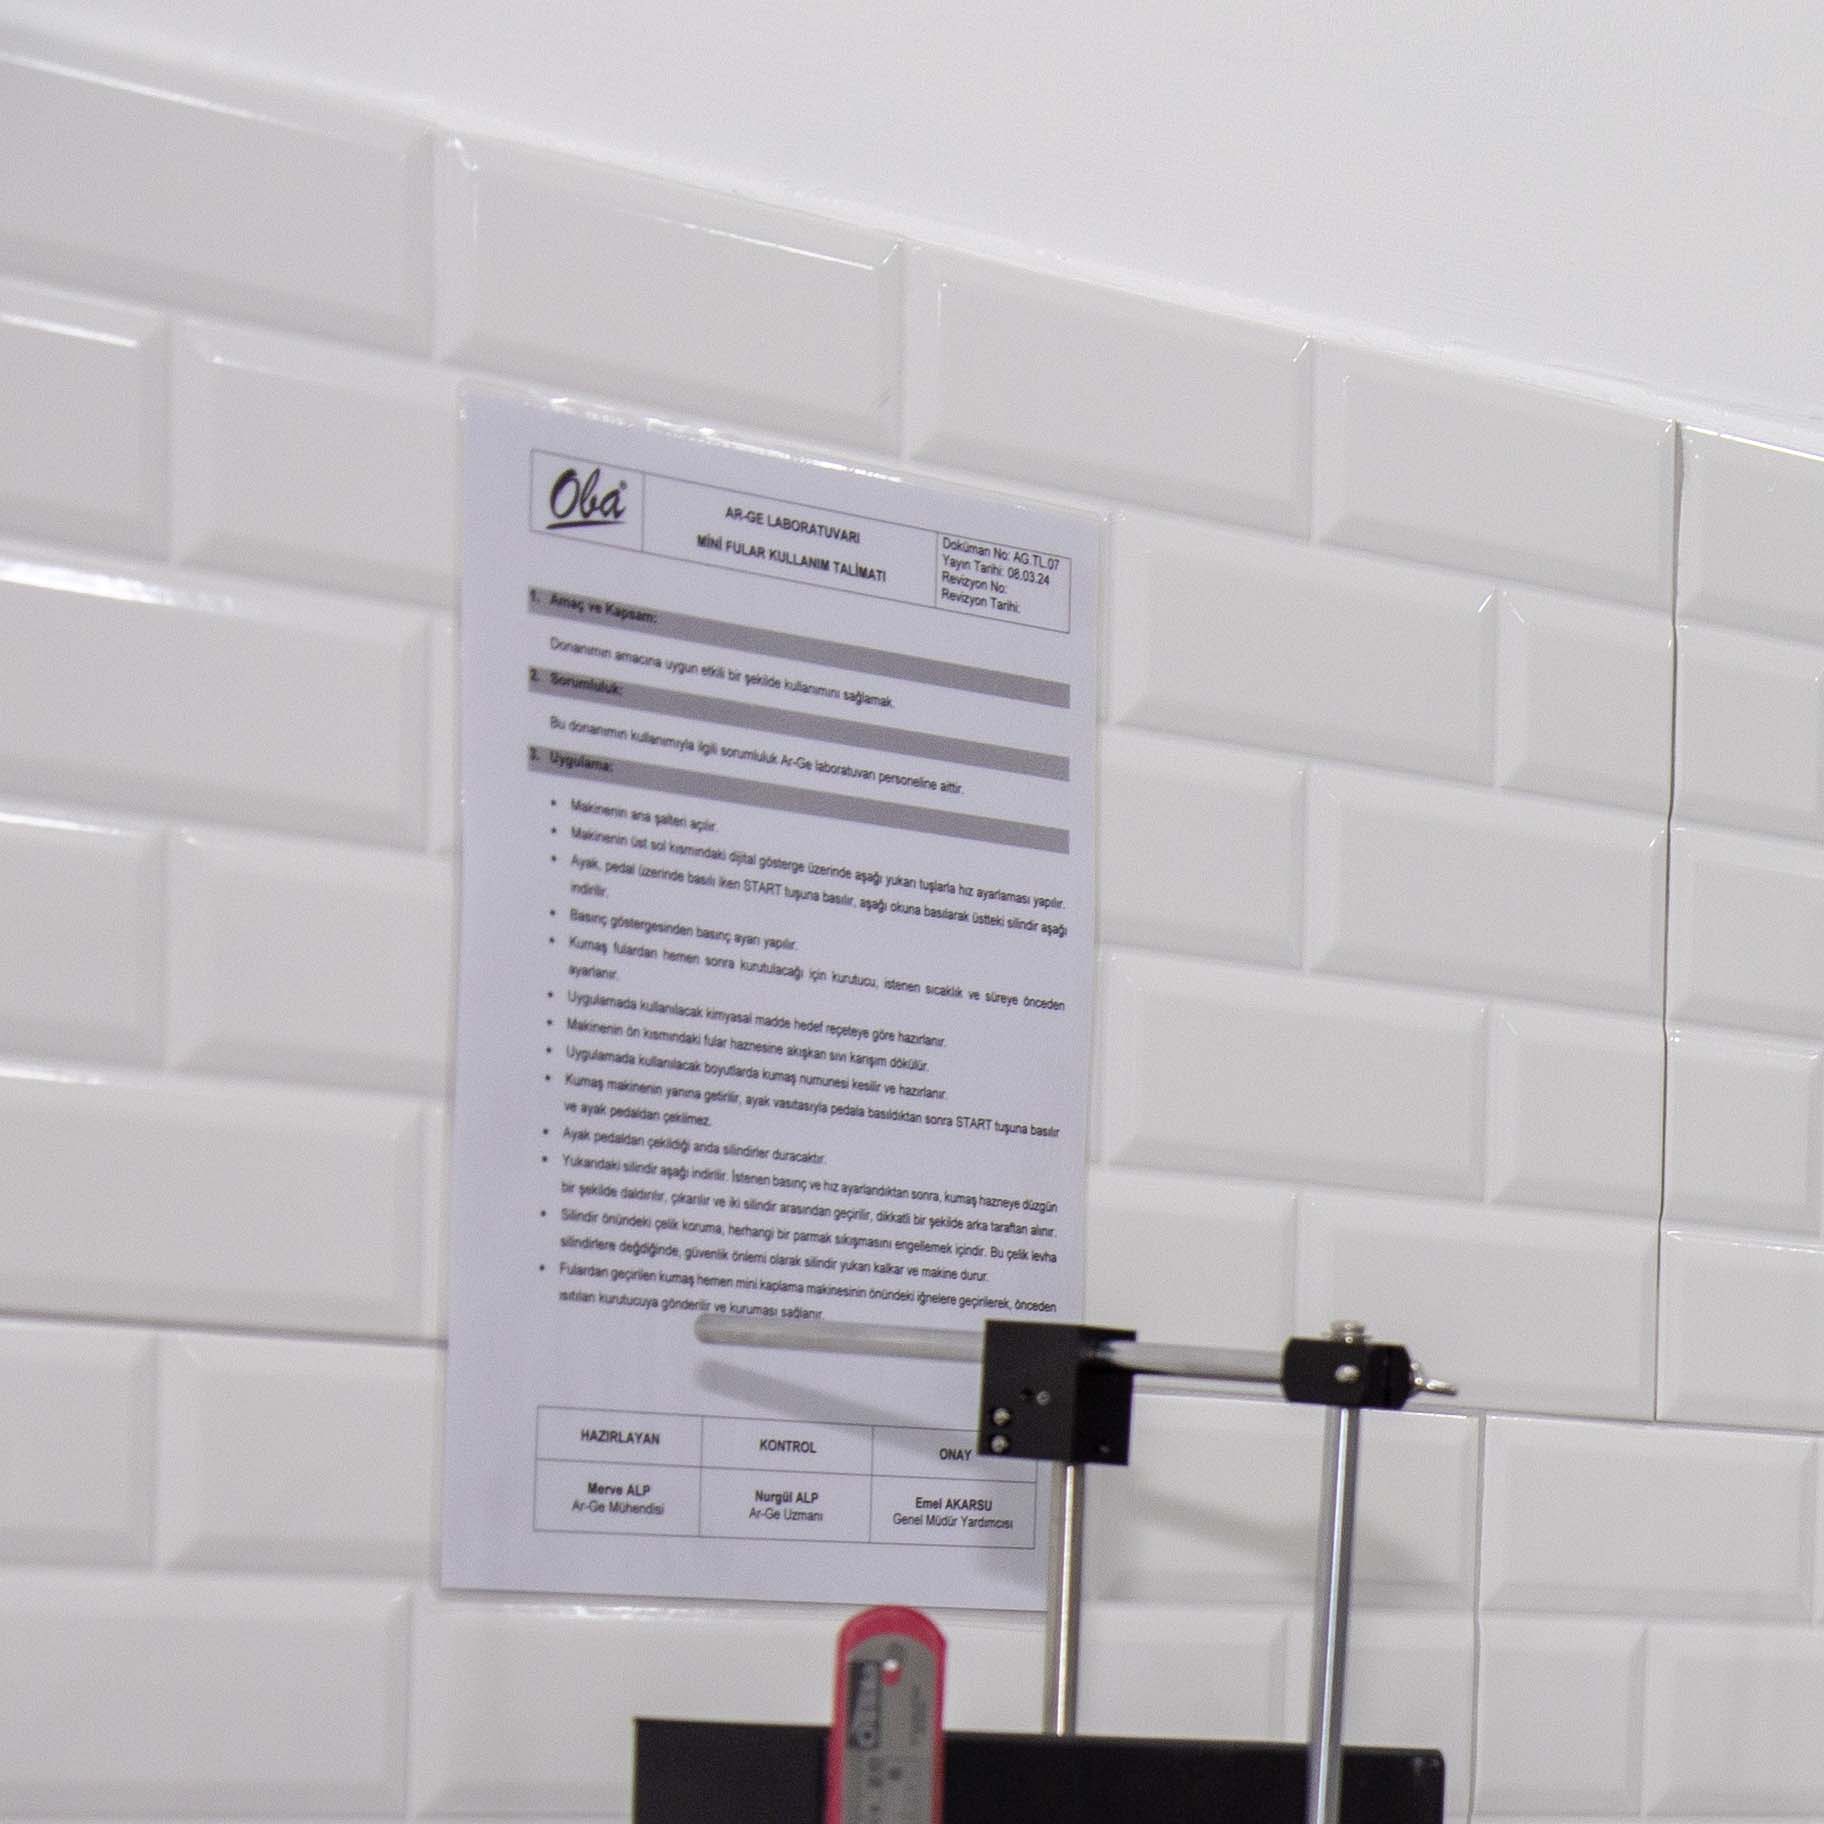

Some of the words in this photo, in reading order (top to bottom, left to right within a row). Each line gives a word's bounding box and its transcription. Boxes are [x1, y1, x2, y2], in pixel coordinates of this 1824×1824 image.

[549, 467, 628, 522] Oba
[724, 506, 764, 525] AR-GE
[766, 514, 860, 544] LABORATUVARI
[696, 533, 722, 551] MİNİ
[724, 539, 765, 559] FULAR
[768, 548, 830, 571] KULLANIM
[832, 560, 886, 582] TALİMATI
[1012, 551, 1060, 570] AG.TL.07
[1006, 566, 1050, 586] 08.03.24
[580, 1428, 660, 1445] HAZIRLAYAN
[759, 1438, 817, 1453] KONTROL
[938, 1447, 971, 1461] ONAY
[587, 1482, 623, 1495] Merve
[625, 1483, 651, 1497] ALP
[754, 1489, 793, 1504] Nurgül
[795, 1491, 819, 1504] ALP
[915, 1496, 942, 1509] Emel
[944, 1498, 992, 1511] AKARSU
